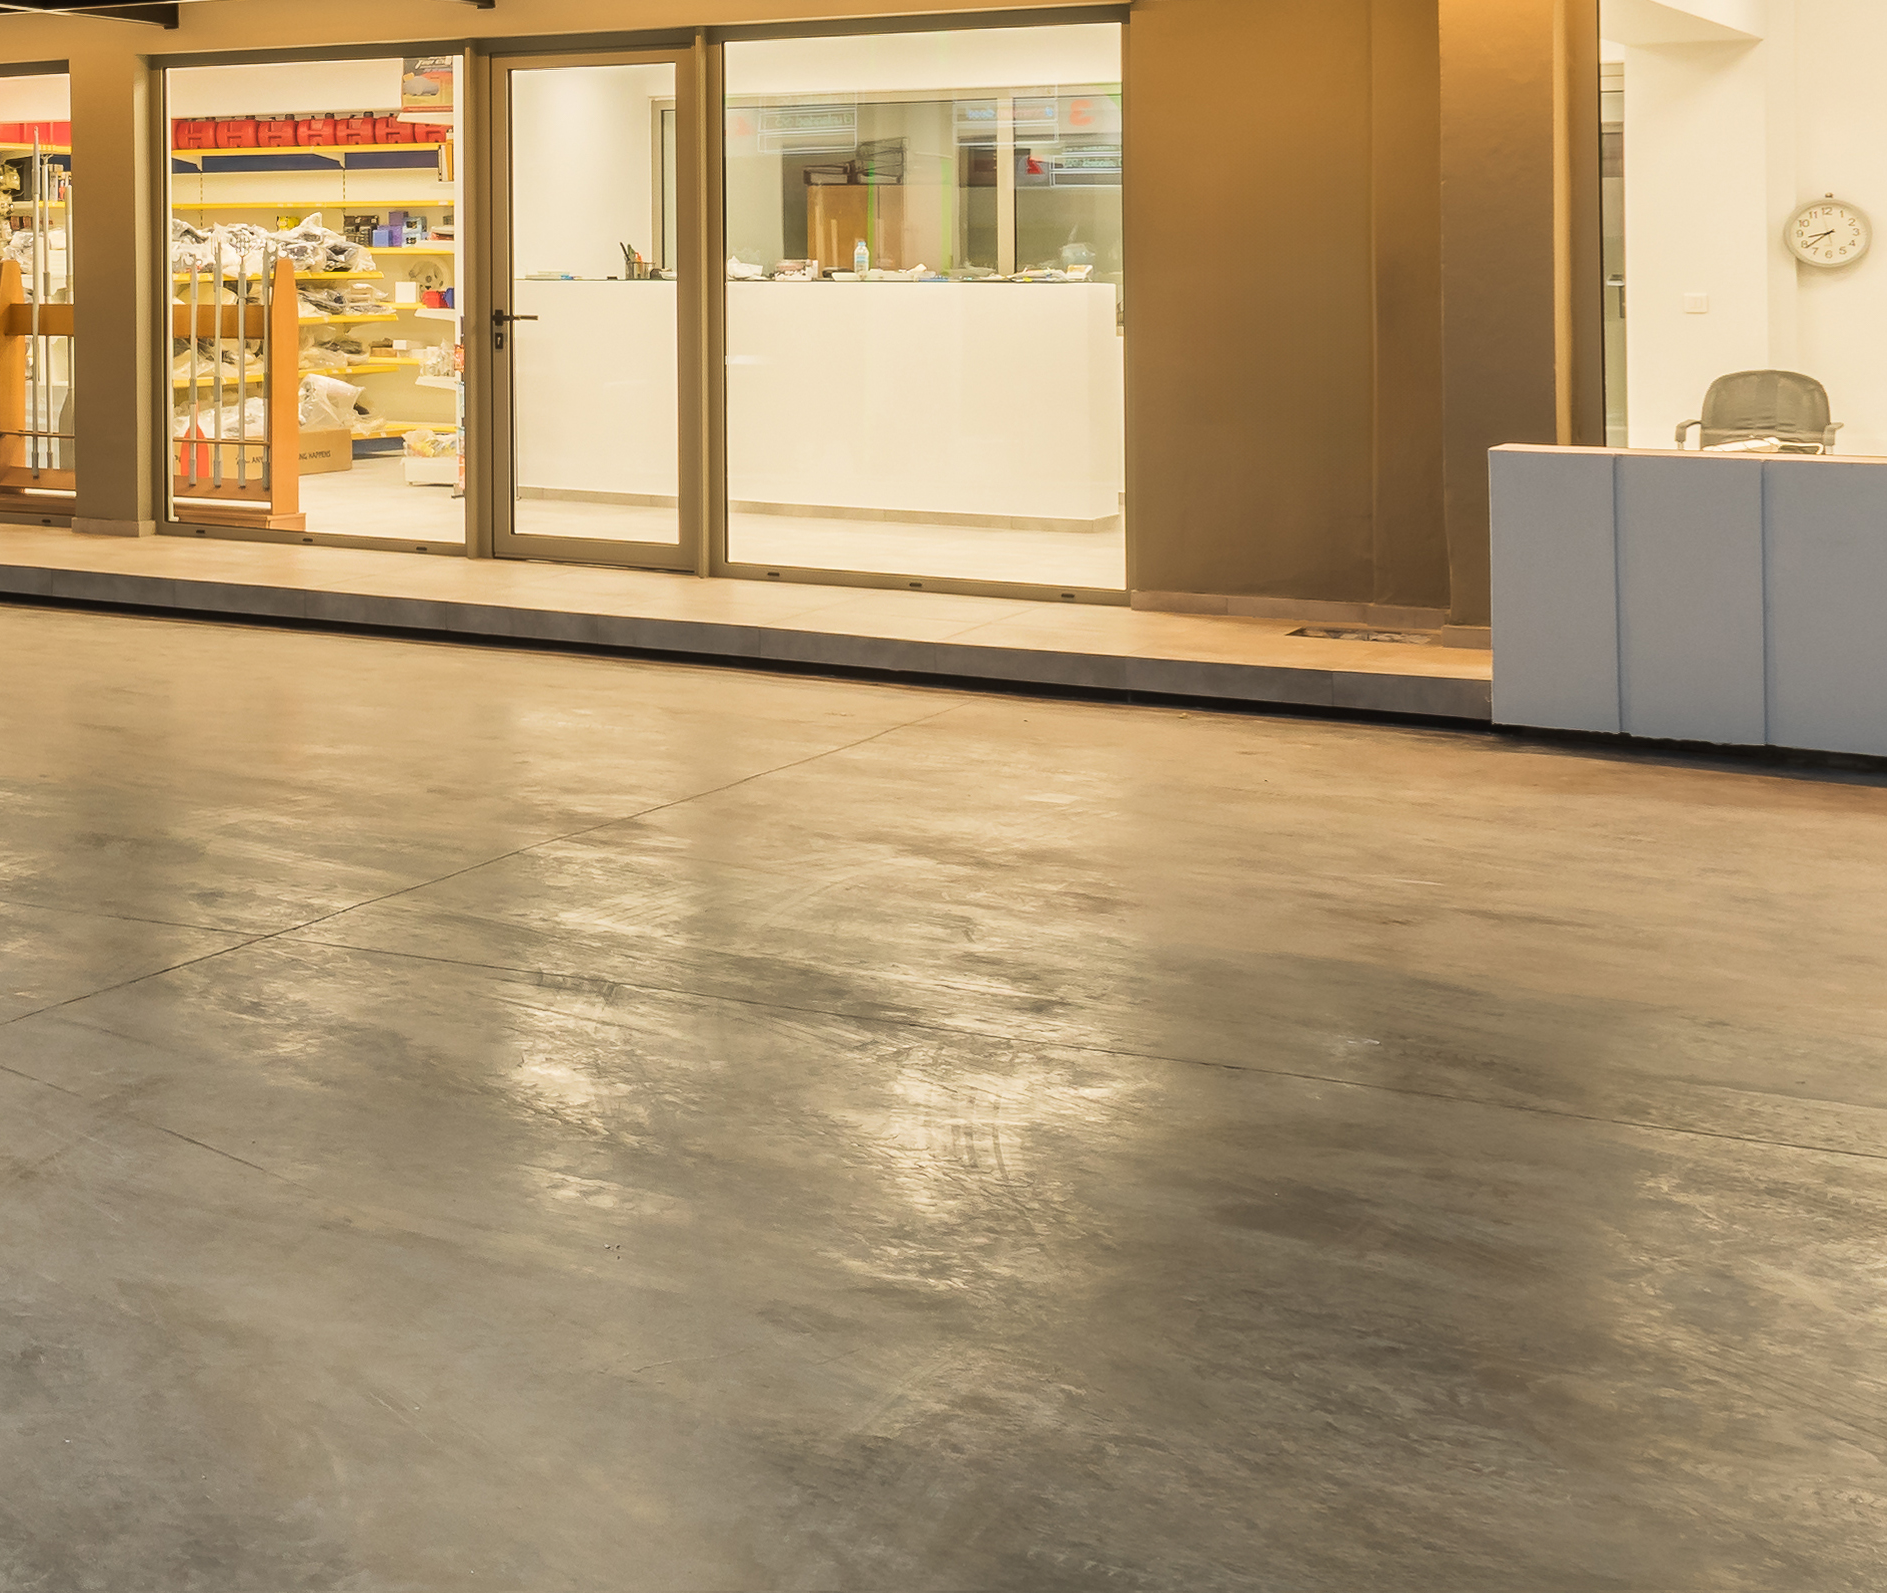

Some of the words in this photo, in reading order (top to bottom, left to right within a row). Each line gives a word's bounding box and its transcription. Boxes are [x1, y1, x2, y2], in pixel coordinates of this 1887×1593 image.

[1809, 211, 1818, 219] 11
[1821, 207, 1832, 215] 12
[1839, 210, 1844, 218] 1
[1798, 219, 1810, 227] 10
[1848, 218, 1856, 226] 2
[1796, 229, 1804, 238] 9
[1852, 228, 1860, 236] 3
[1812, 247, 1819, 255] 7
[1825, 250, 1833, 259] 6
[1839, 246, 1847, 255] 5
